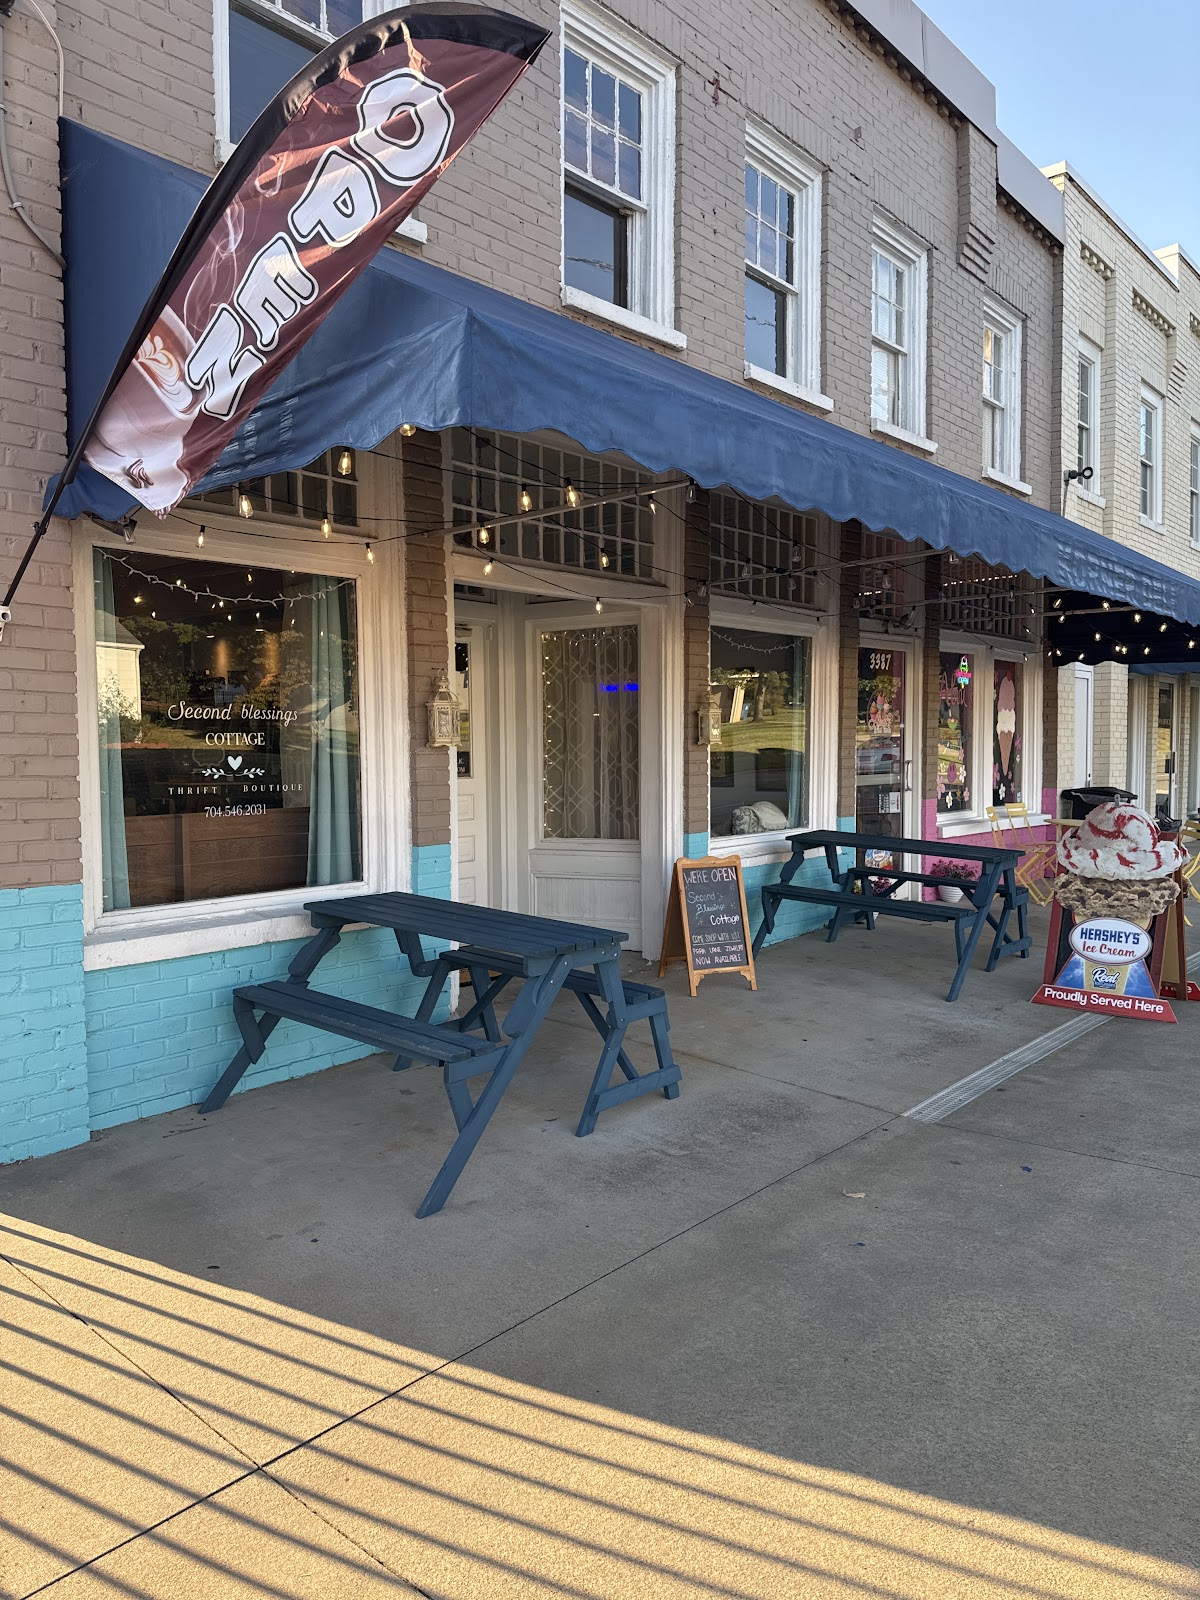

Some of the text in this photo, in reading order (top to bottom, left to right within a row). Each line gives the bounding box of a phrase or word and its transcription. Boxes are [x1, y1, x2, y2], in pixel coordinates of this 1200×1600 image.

[185, 67, 455, 421] OPEN
[869, 652, 892, 671] 3387
[167, 700, 298, 727] Second blessings
[205, 732, 266, 746] COTTAGE
[168, 783, 304, 795] THRIFT BOUTIQUE
[204, 804, 267, 818] 704.546.2031
[710, 866, 737, 882] OPEN
[687, 891, 715, 904] Second
[710, 914, 740, 926] Cottage
[1080, 927, 1141, 945] HERSHEY'S
[1082, 940, 1137, 958] Ice Cream
[695, 955, 711, 965] NOW
[1092, 966, 1121, 984] Real
[1044, 987, 1164, 1014] Proudly Served Here
